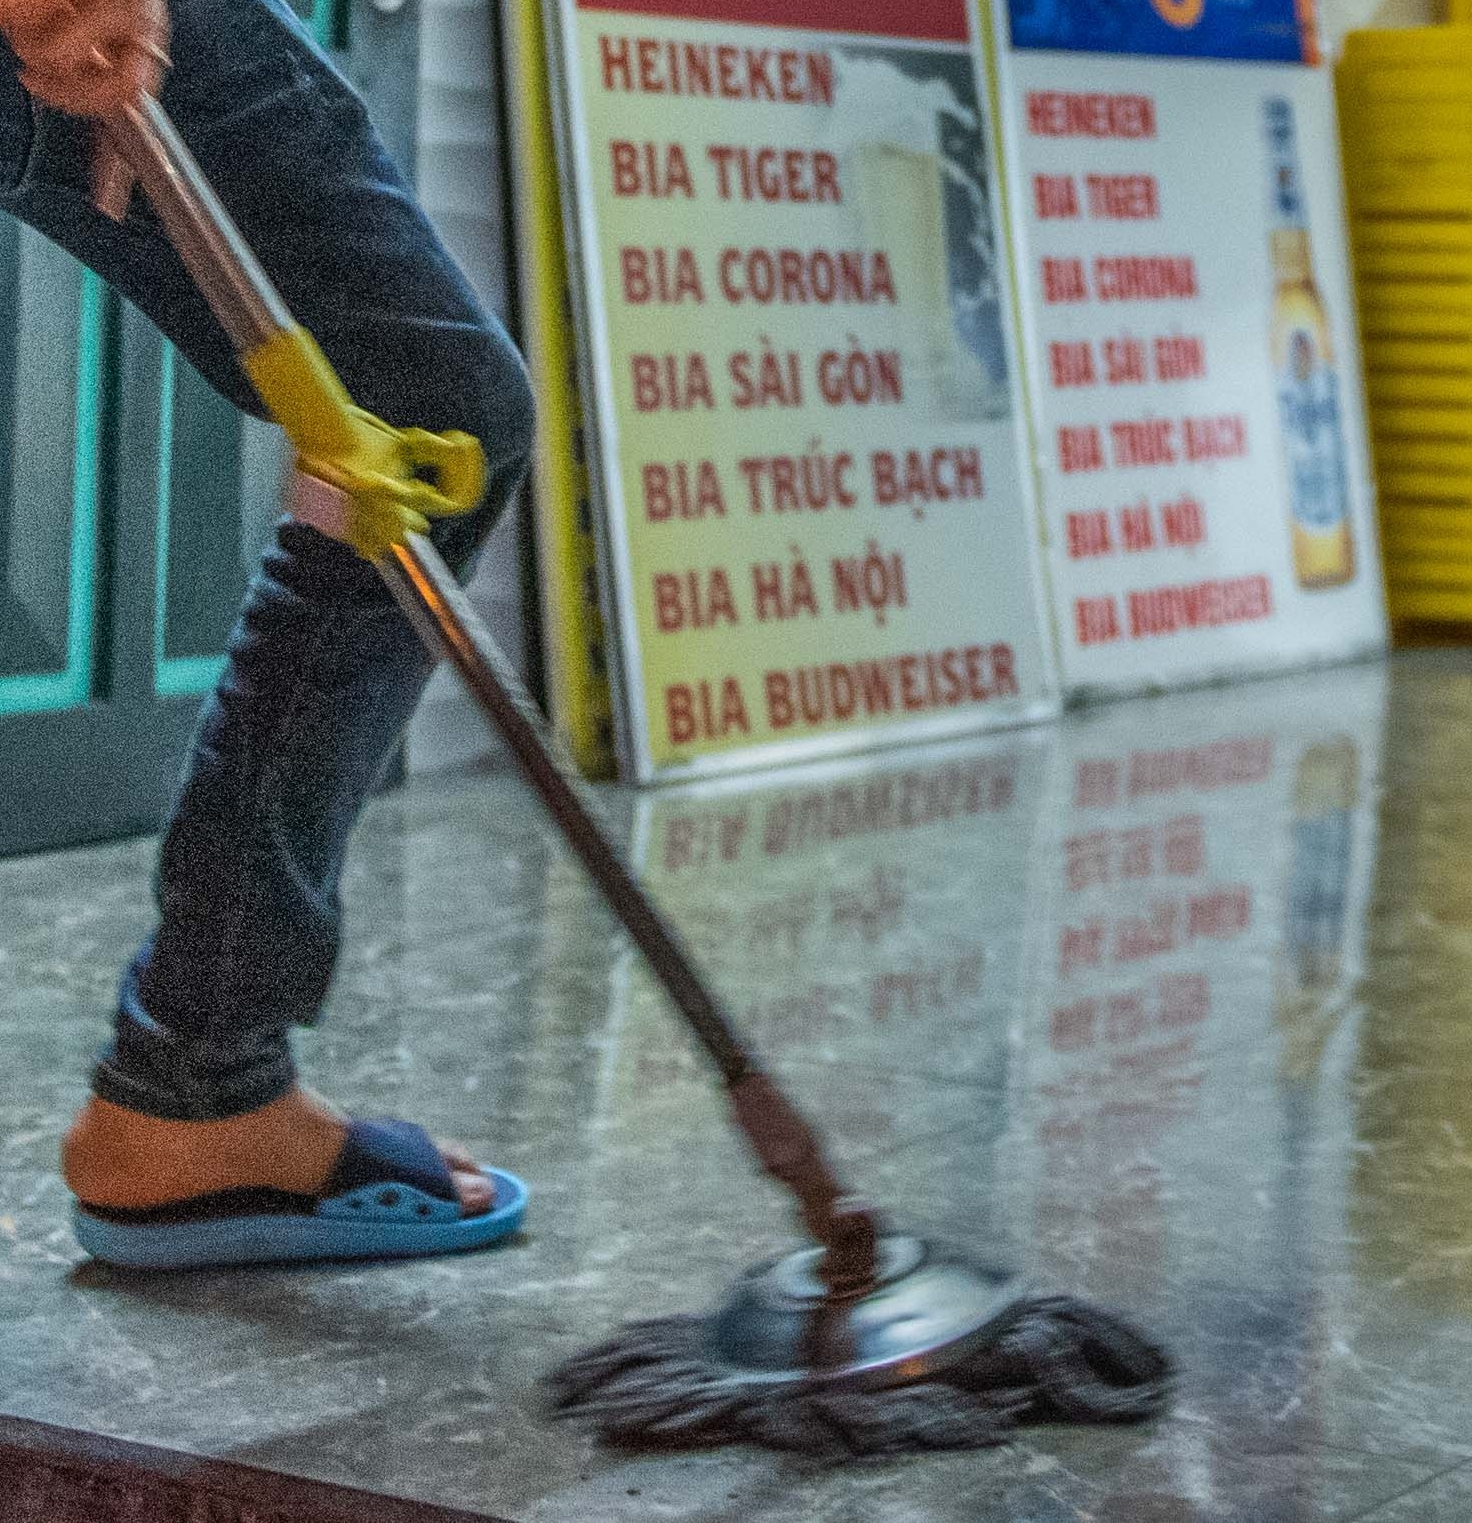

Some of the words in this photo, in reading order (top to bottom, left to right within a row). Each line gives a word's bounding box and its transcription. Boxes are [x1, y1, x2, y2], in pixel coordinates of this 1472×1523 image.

[598, 33, 834, 107] HEINEKEN
[609, 139, 695, 201] BIA
[705, 143, 843, 204] TIGER
[1033, 173, 1079, 220] BIA
[1086, 172, 1159, 220] TIGER
[619, 245, 705, 306] BIA
[718, 246, 898, 306] CORONA
[1041, 256, 1088, 305] BIA
[630, 351, 716, 413] BIA
[726, 333, 803, 410] SÀI
[817, 332, 903, 406] GÒN
[1049, 340, 1097, 390] BIA
[1057, 421, 1104, 474] BIA
[642, 459, 727, 523] BIA
[737, 436, 857, 514] TRÚC
[871, 446, 985, 521] BẠCH
[1066, 509, 1113, 561] BIA
[653, 568, 738, 633] BIA
[751, 543, 819, 622] HÀ
[832, 539, 909, 628] NỘI
[1075, 595, 1121, 647] BIA
[665, 677, 752, 745] BIA
[764, 642, 1021, 730] BUDWEISER
